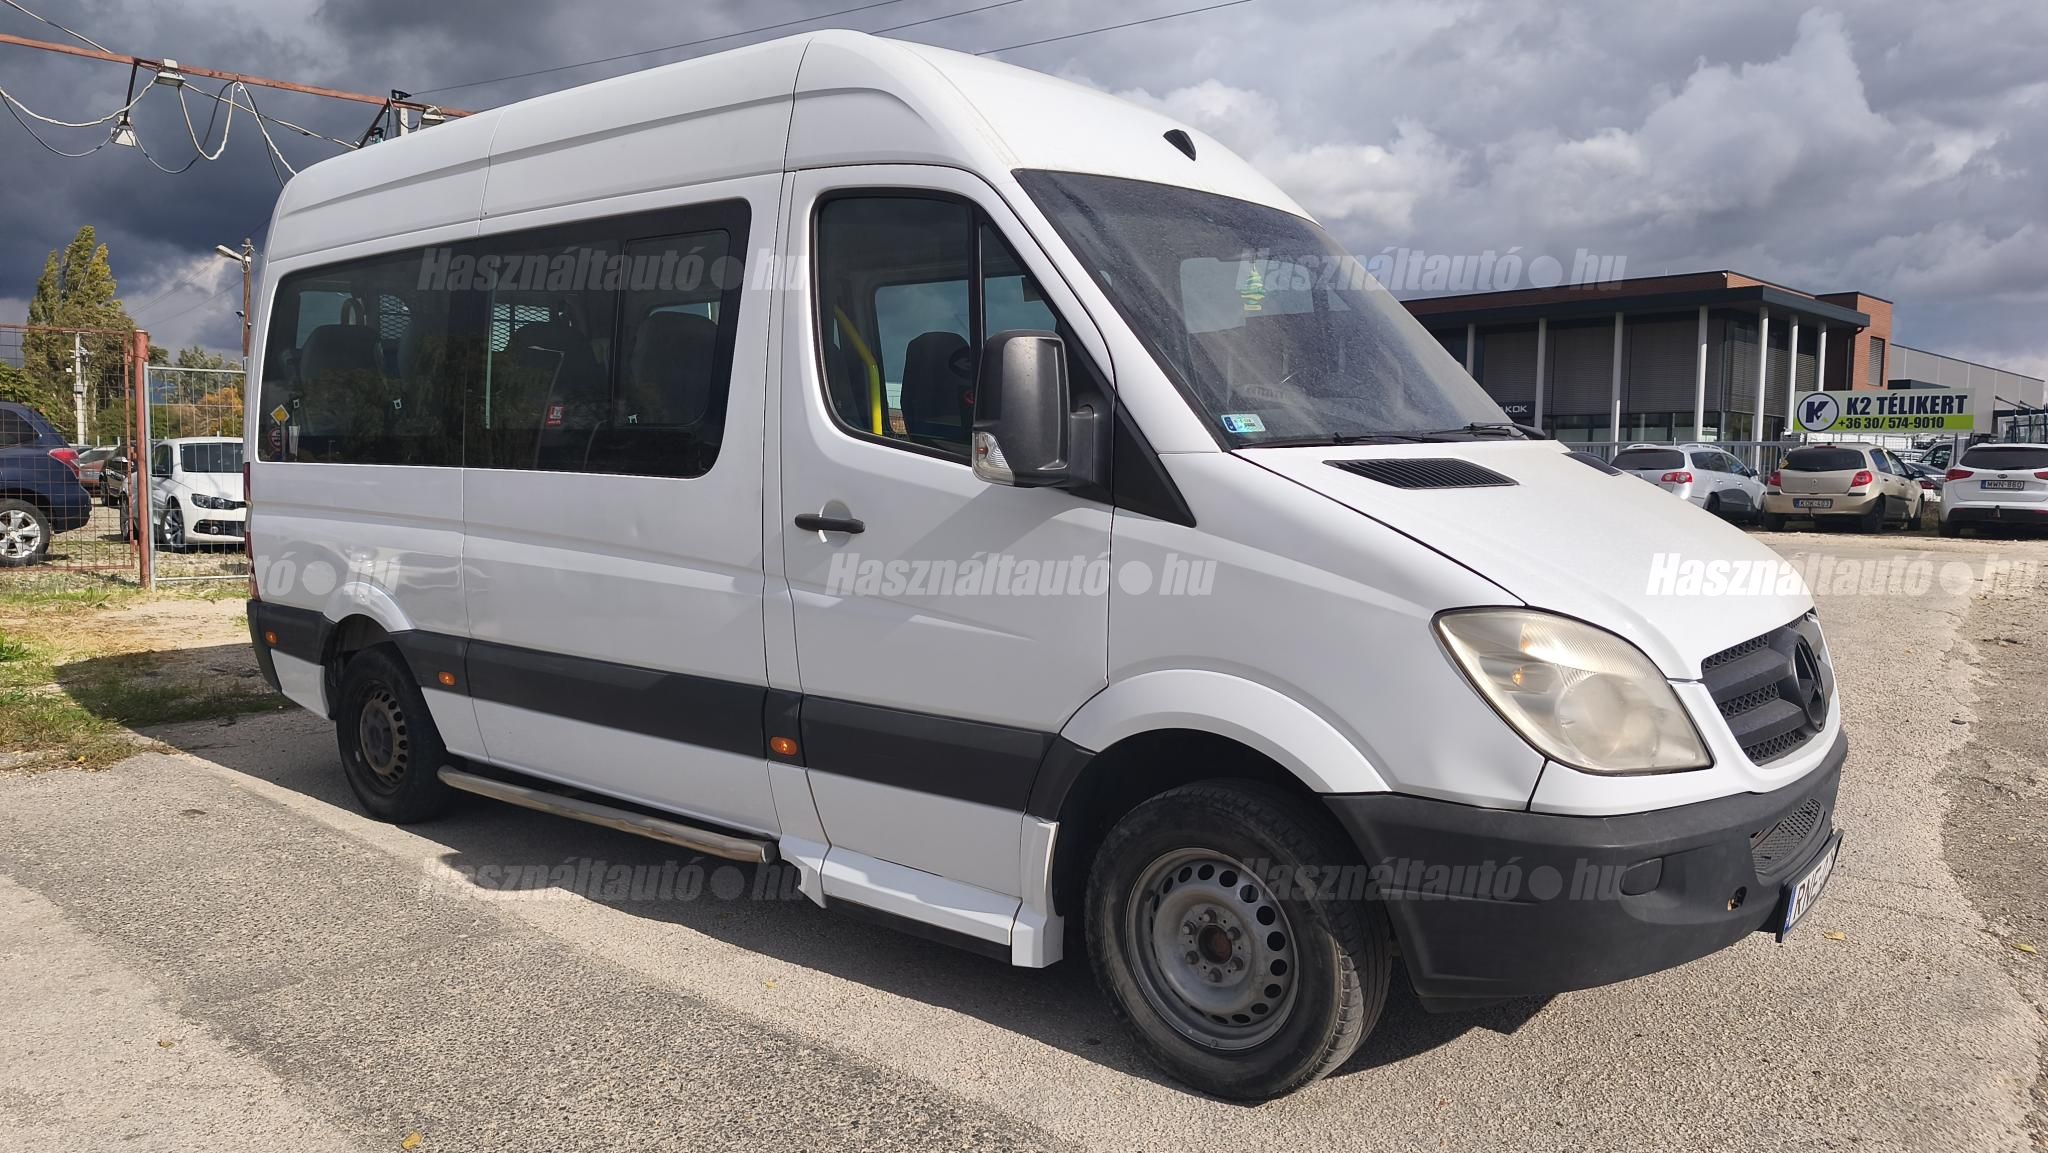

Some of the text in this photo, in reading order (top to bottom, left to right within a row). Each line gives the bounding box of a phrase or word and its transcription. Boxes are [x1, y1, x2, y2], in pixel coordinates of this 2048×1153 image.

[1846, 393, 1968, 416] K2 TÉLIKERT
[1838, 416, 1862, 429] +36
[1888, 416, 1944, 429] 574-9010
